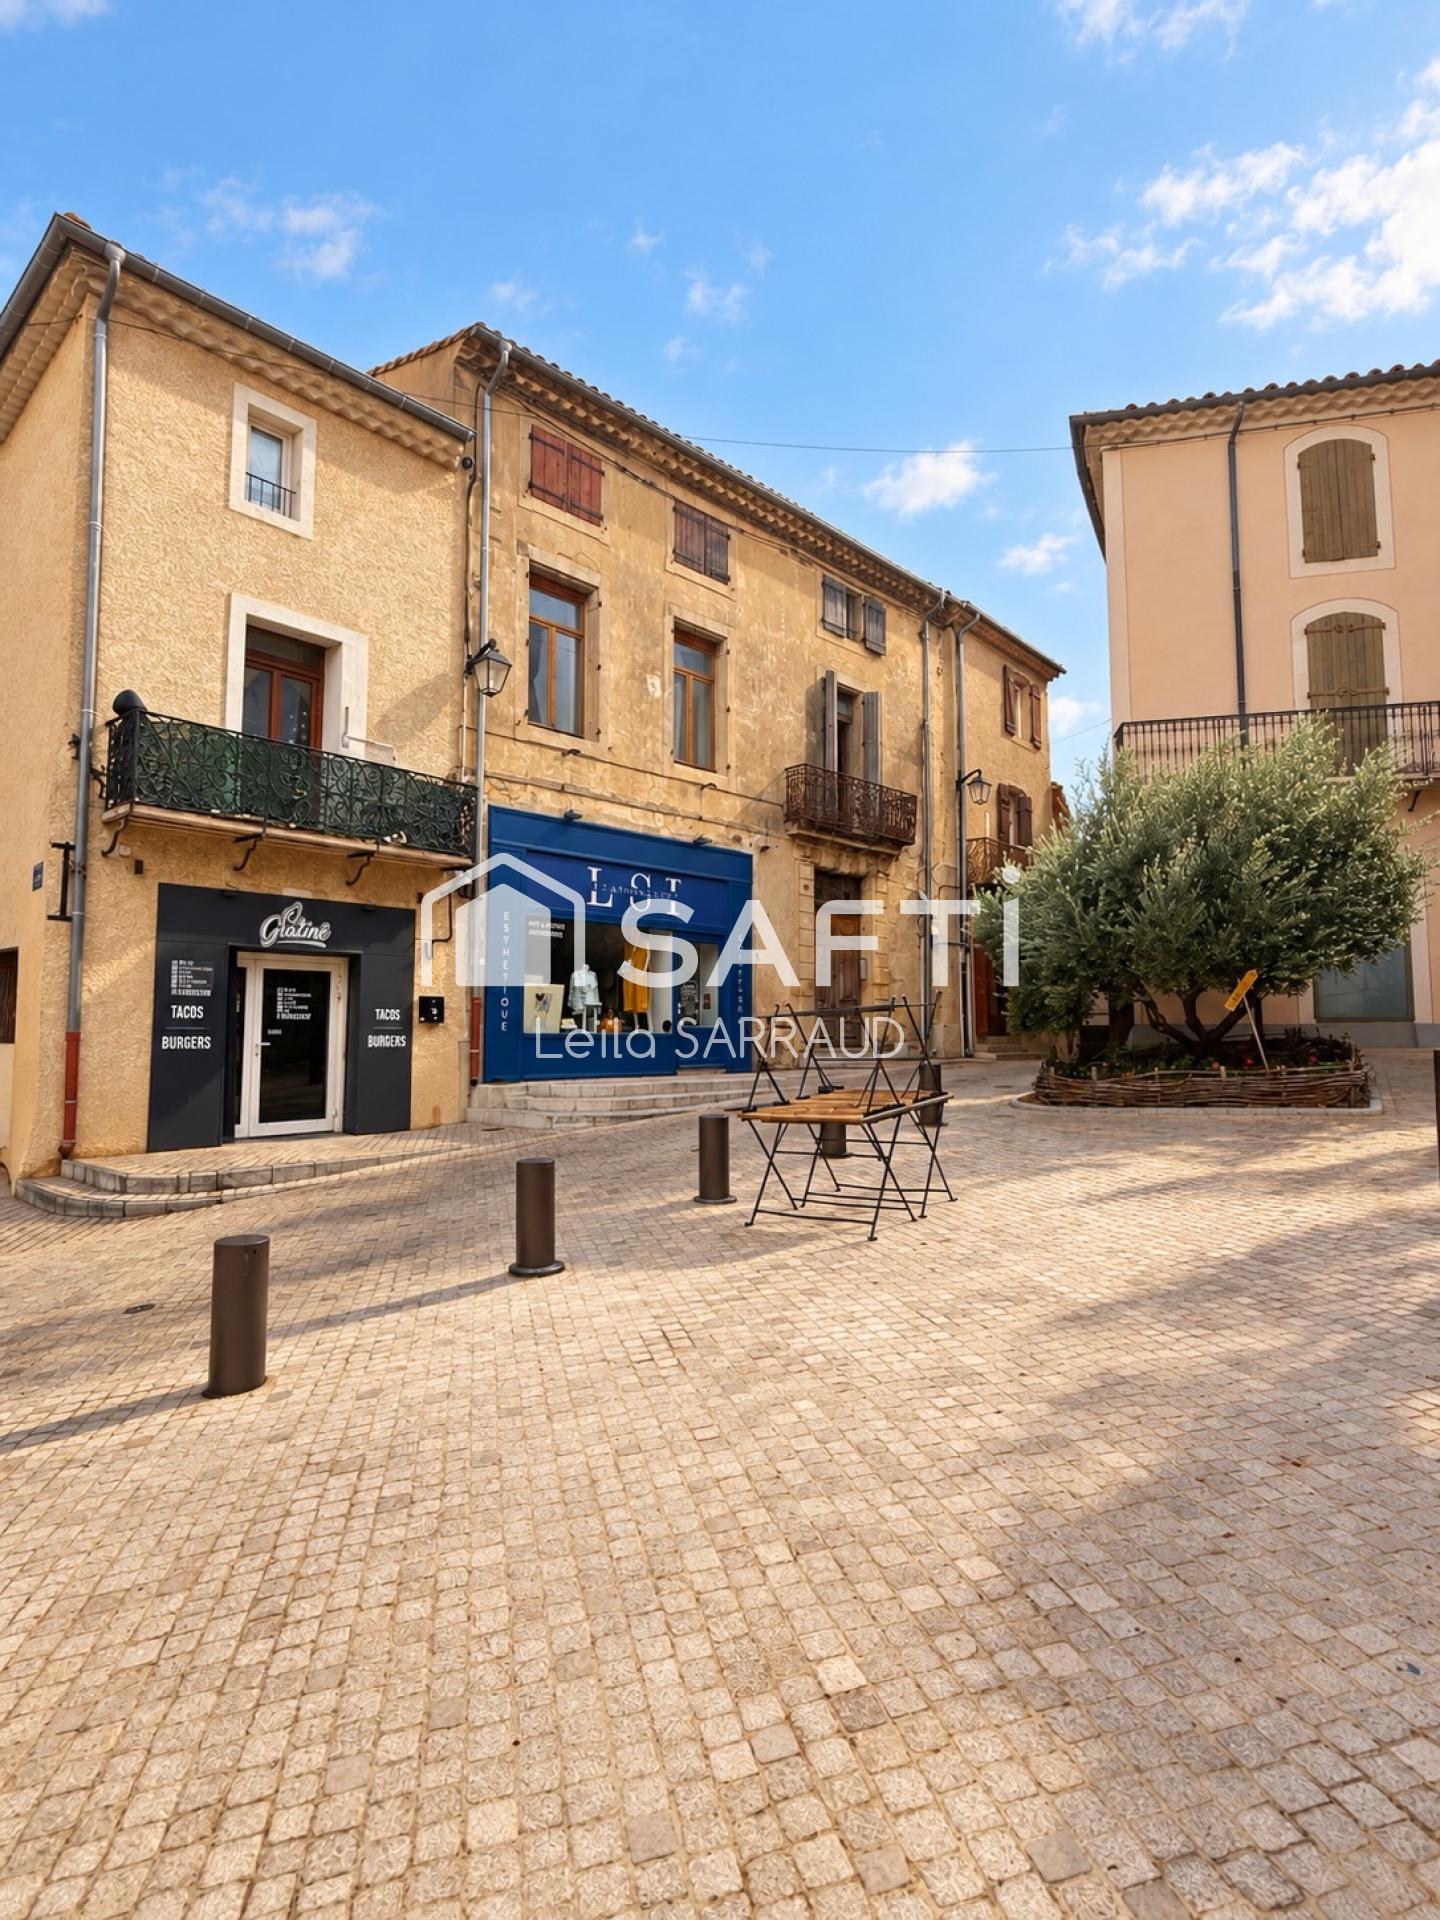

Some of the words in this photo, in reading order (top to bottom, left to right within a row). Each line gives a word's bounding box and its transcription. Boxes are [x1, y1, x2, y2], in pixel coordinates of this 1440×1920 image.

[171, 1004, 204, 1019] TACOS
[375, 1008, 401, 1021] TACOS
[162, 1035, 212, 1050] BURGERS
